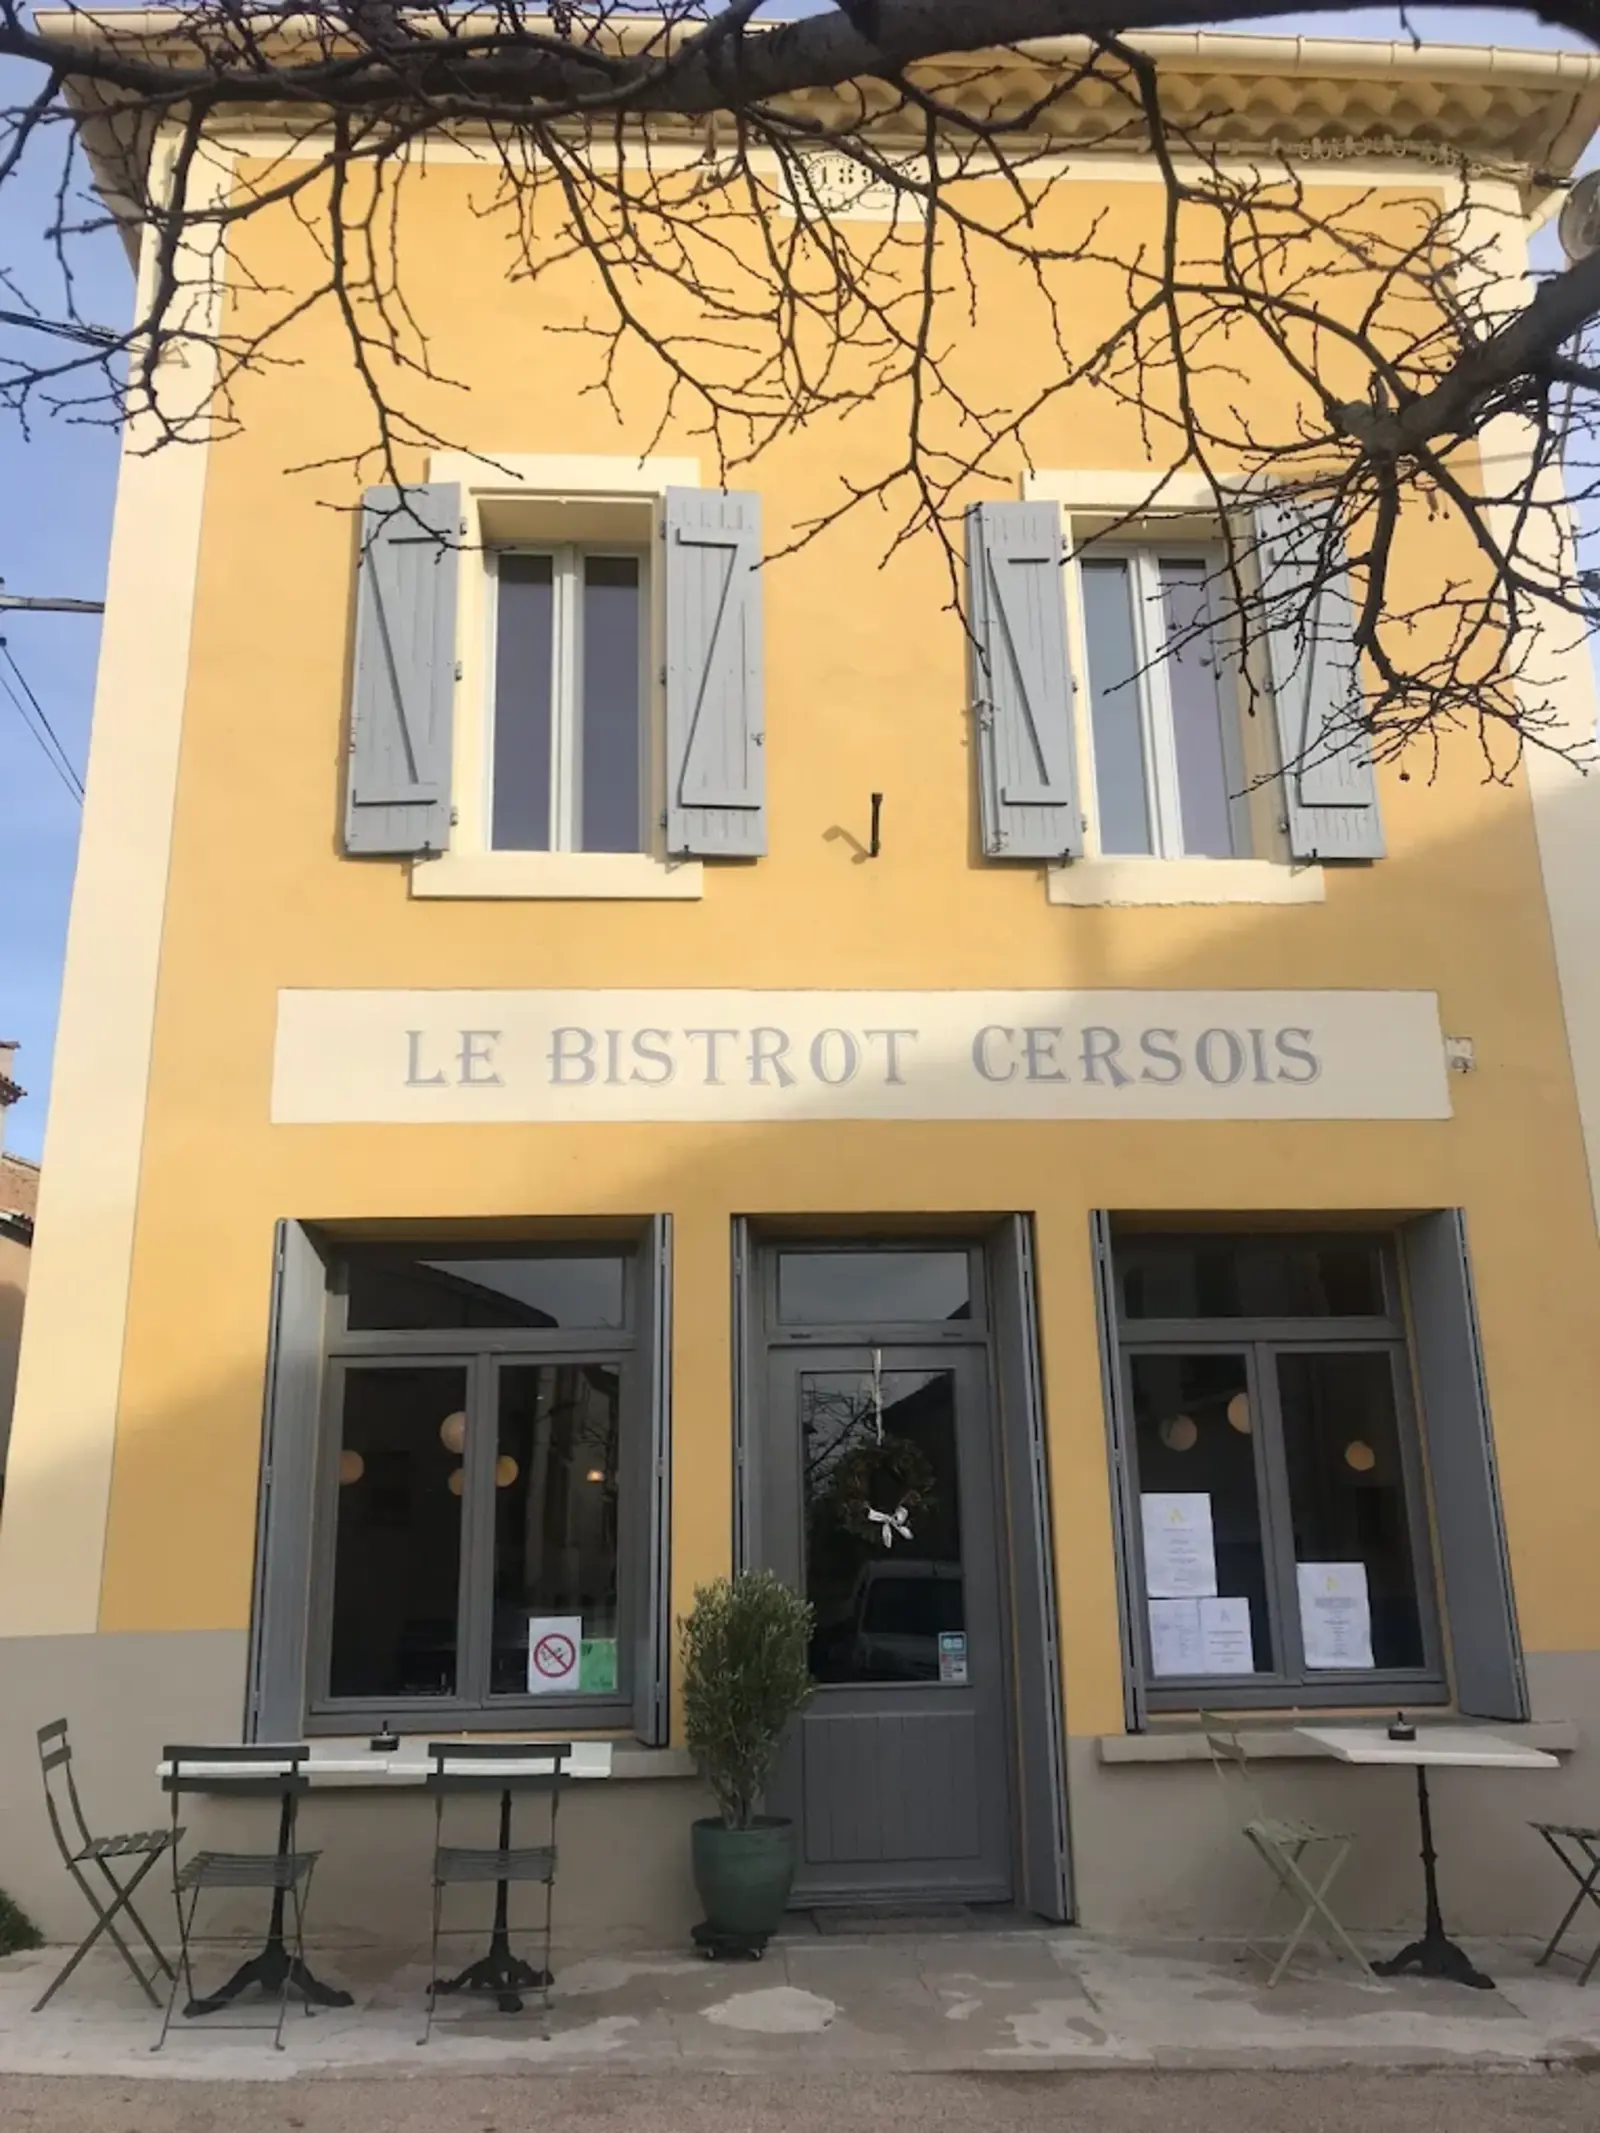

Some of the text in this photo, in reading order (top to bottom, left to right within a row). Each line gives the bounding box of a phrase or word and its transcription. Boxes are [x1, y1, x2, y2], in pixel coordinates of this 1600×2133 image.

[404, 1024, 1323, 1089] LE BISTROT CERSOIS
